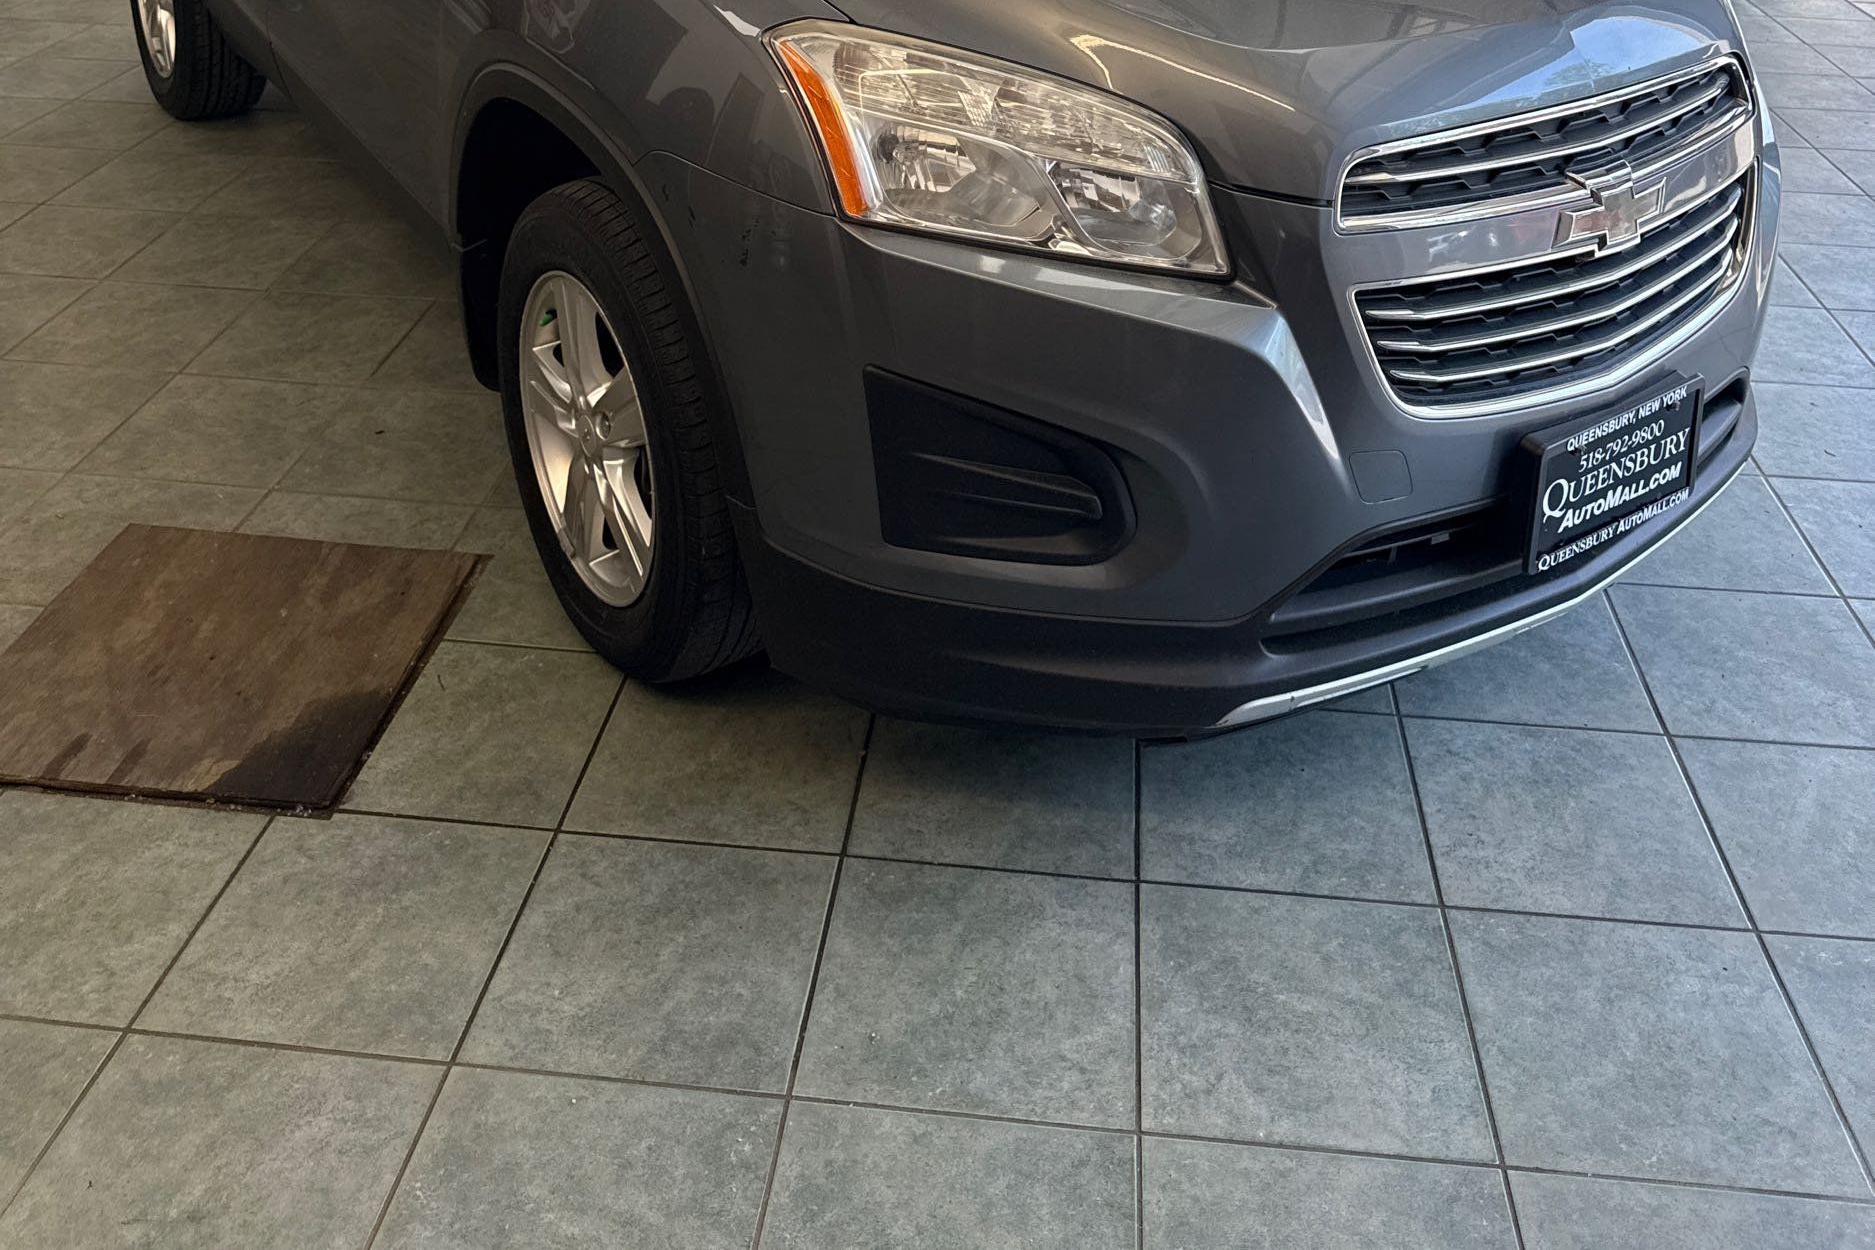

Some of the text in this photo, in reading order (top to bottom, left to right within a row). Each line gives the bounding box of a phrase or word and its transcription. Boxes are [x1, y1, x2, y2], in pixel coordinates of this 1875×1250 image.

[1566, 386, 1687, 452] QUEENSBURY, NEW YORK
[1578, 419, 1665, 473] 518-792-9800
[1542, 428, 1690, 524] QUEENSBURY
[1537, 524, 1617, 573] QUEENSBURY
